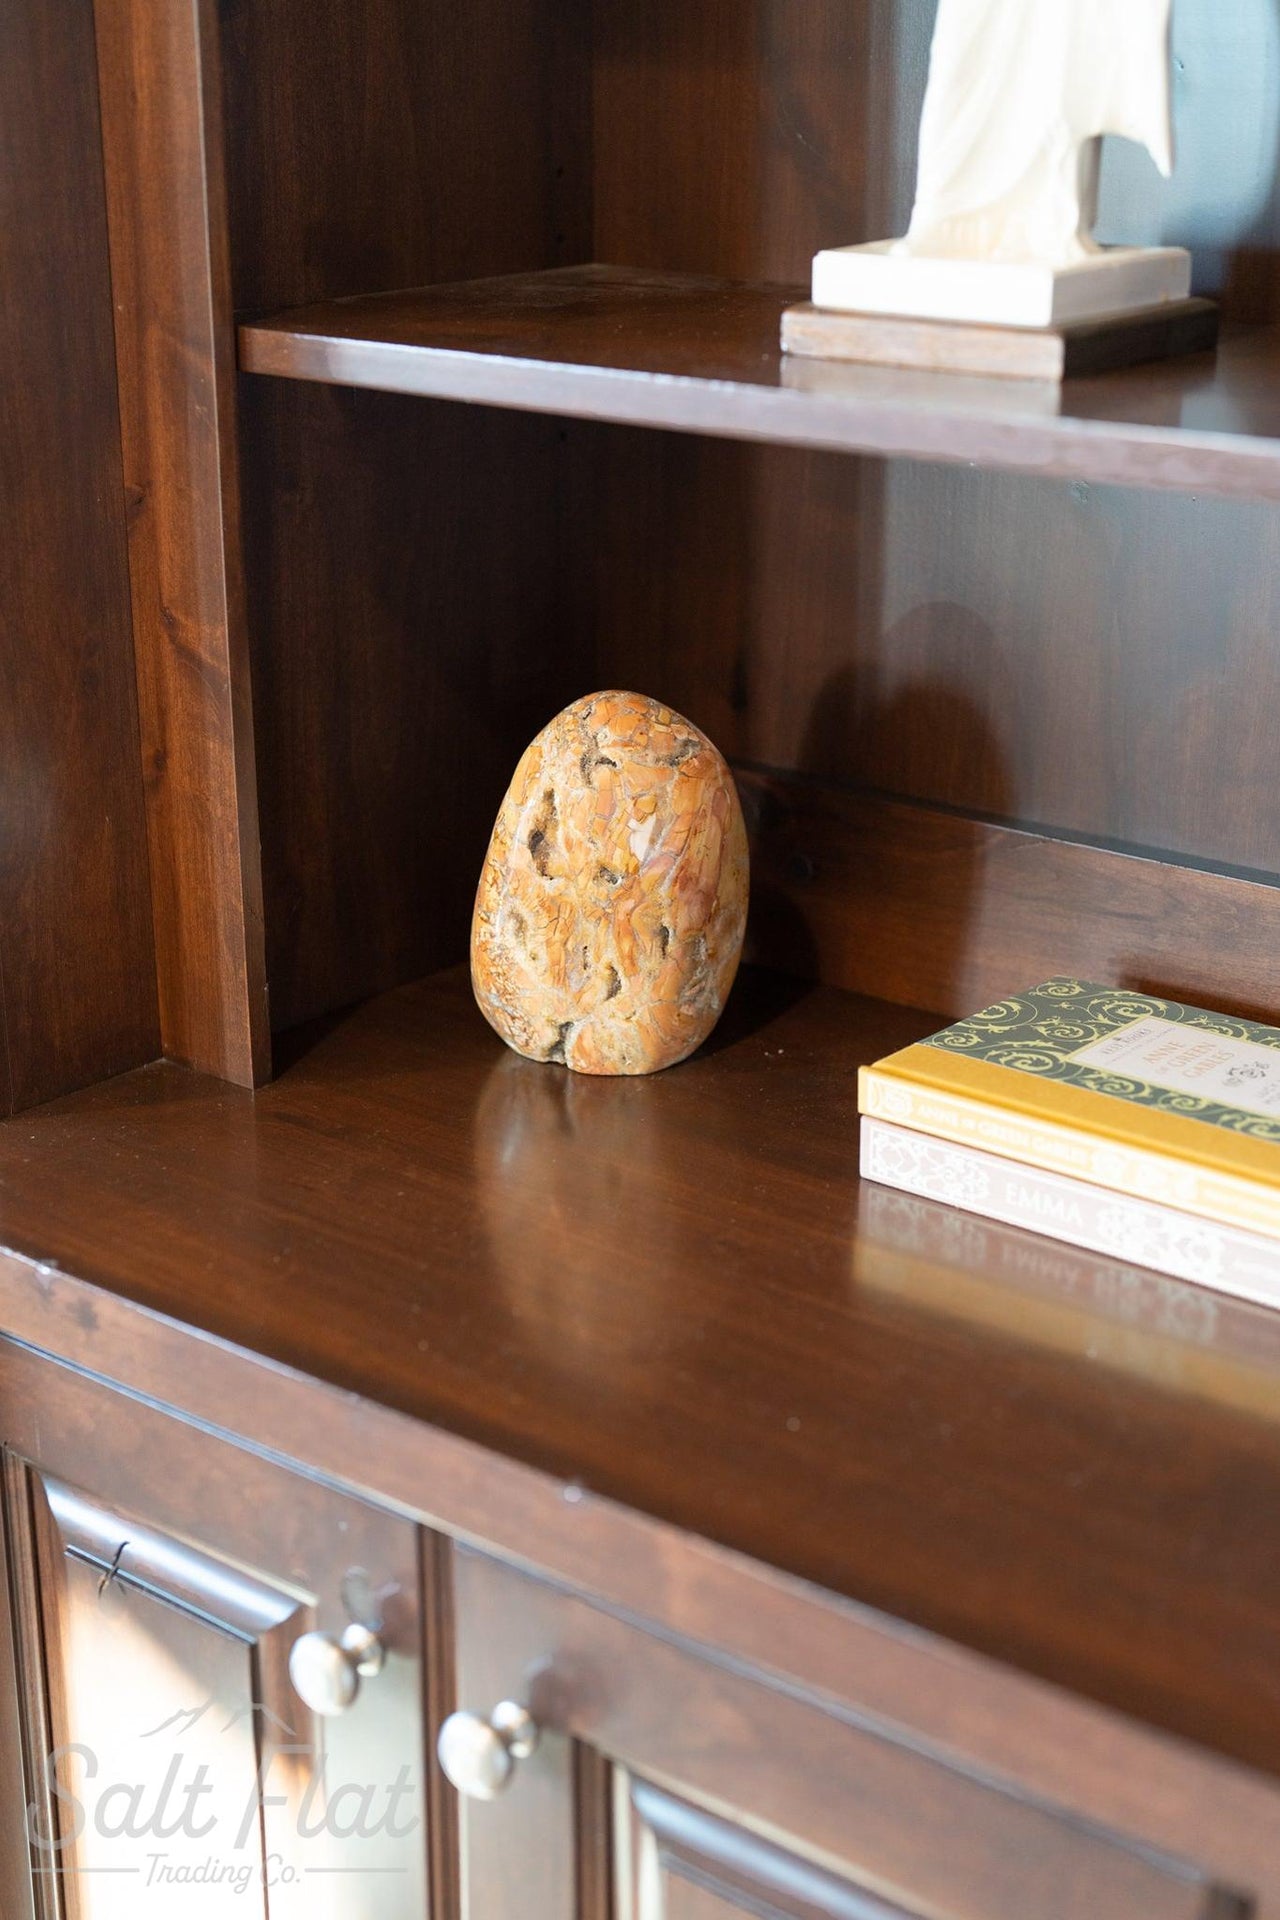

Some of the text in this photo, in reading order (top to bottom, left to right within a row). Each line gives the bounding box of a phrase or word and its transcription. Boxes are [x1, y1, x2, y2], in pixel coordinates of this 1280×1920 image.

[1142, 1042, 1184, 1064] ANNE
[1167, 1041, 1217, 1067] GREEN
[1182, 1051, 1234, 1078] GABLES
[1005, 1182, 1082, 1226] EMMA
